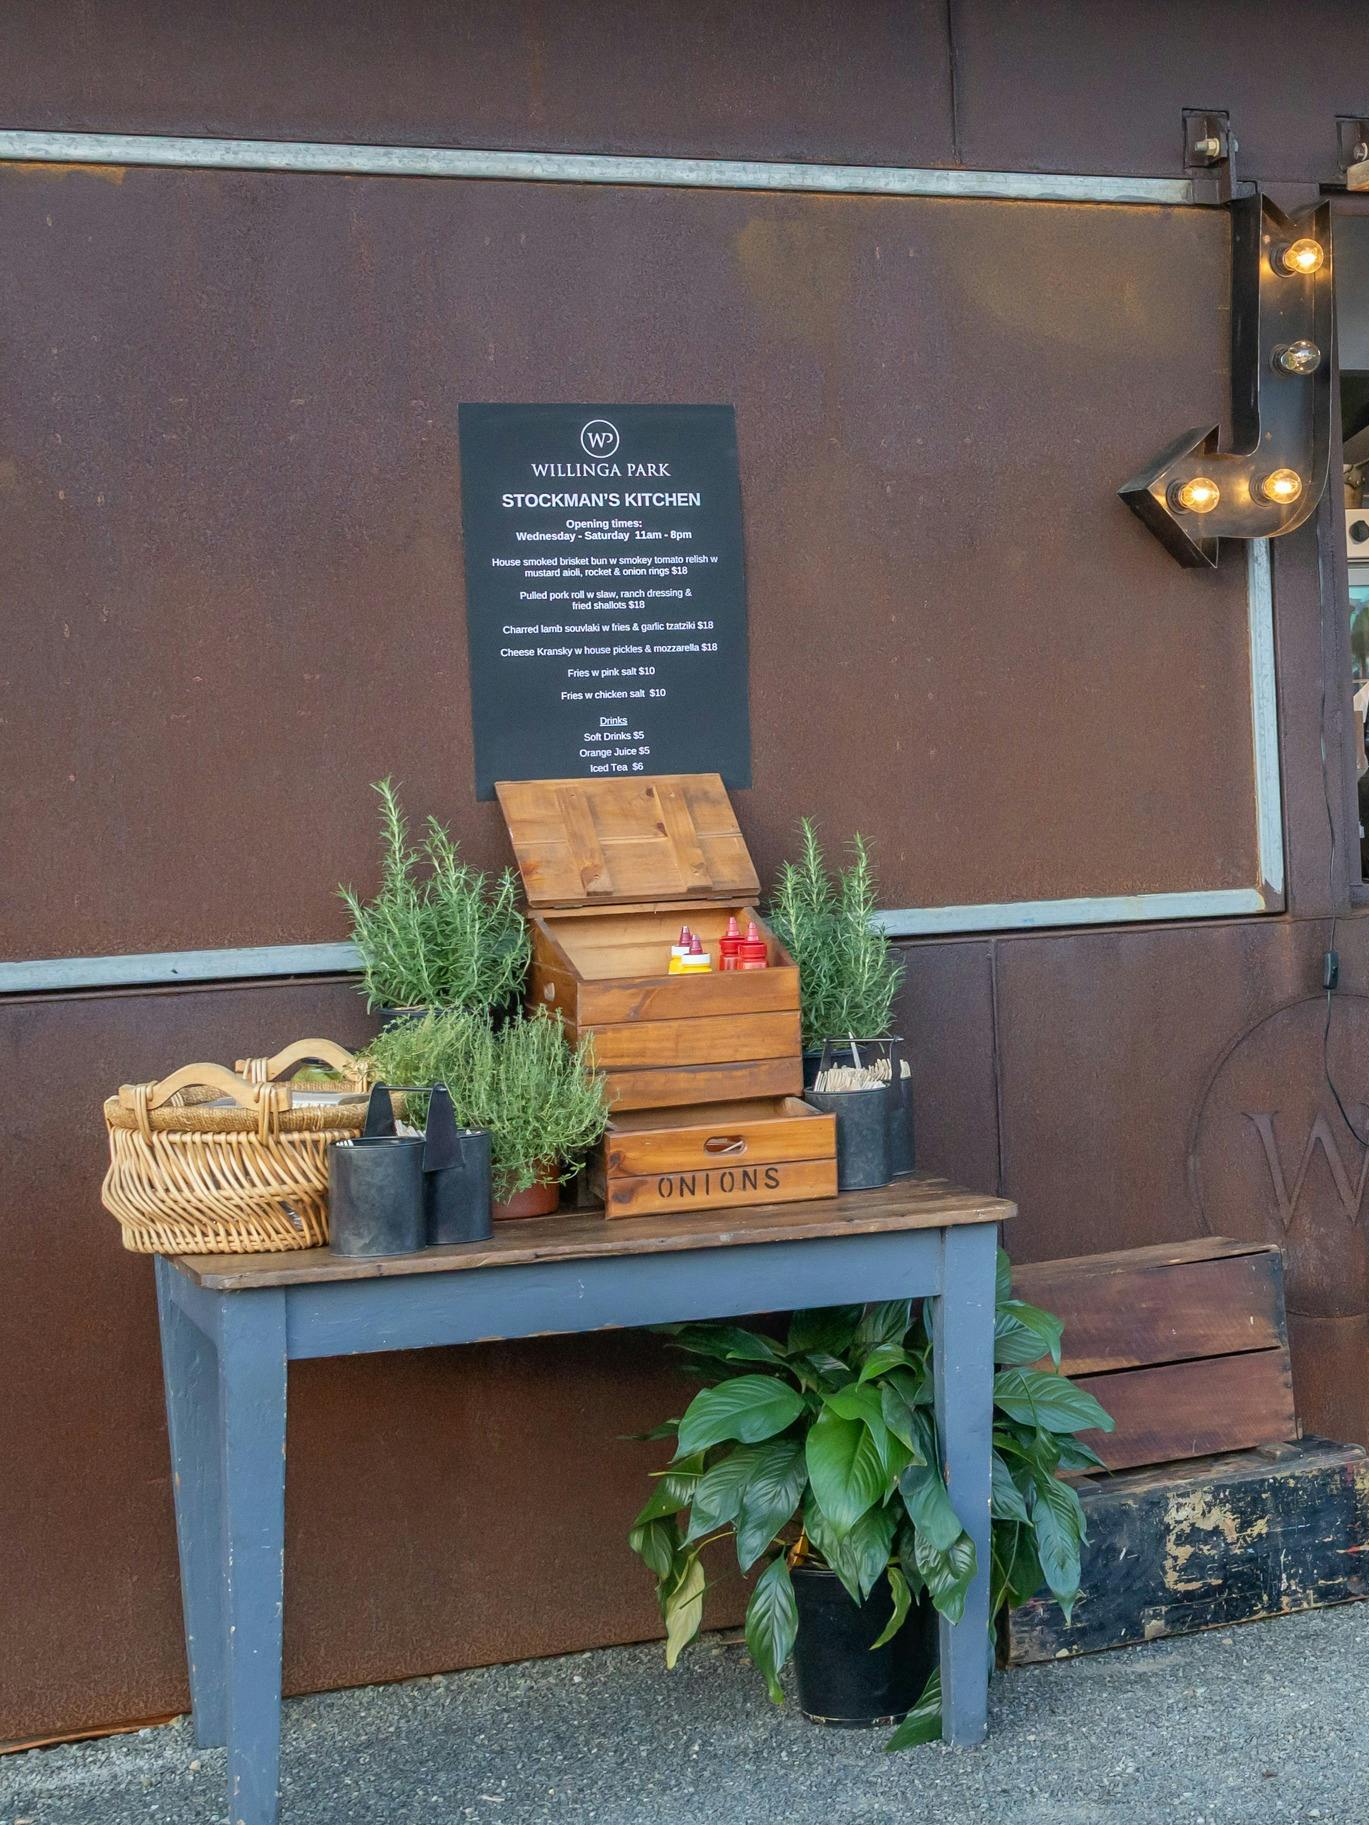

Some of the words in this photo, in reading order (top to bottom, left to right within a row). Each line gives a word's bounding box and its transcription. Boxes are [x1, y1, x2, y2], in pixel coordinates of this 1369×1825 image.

[531, 463, 622, 477] WILLINGA
[627, 463, 671, 477] PARK
[502, 493, 621, 508] STOCKMAN'S
[624, 492, 701, 507] KITCHEN
[566, 518, 610, 531] Opening
[611, 518, 643, 528] times:
[515, 531, 577, 543] Wednesday
[584, 529, 630, 542] Saturday
[634, 530, 663, 540] 11am
[670, 530, 692, 541] 8pm
[491, 558, 521, 567] House
[522, 557, 558, 566] smoked
[559, 556, 590, 566] brisket
[590, 556, 608, 565] bun
[618, 555, 653, 566] smokey
[654, 556, 684, 564] tomato
[685, 554, 709, 564] relish
[524, 568, 561, 577] mustard
[562, 568, 583, 578] aioli,
[584, 567, 612, 577] rocket
[613, 567, 621, 576] &
[622, 566, 647, 576] onion
[648, 566, 670, 577] rings
[671, 566, 688, 575] $18
[519, 590, 548, 600] Pulled
[549, 590, 570, 601] pork
[571, 590, 585, 599] roll
[596, 590, 619, 599] slaw,
[620, 589, 646, 598] ranch
[646, 588, 684, 599] dressing
[684, 588, 693, 597] &
[572, 601, 592, 610] fried
[593, 600, 627, 610] shallots
[628, 600, 646, 609] $18
[502, 624, 539, 635] Charred
[540, 624, 563, 633] lamb
[564, 623, 601, 633] souvlaki
[611, 623, 631, 632] fries
[632, 622, 640, 631] &
[640, 622, 665, 633] garlic
[665, 621, 696, 630] tzatziki
[697, 620, 714, 630] $18
[500, 648, 535, 657] Cheese
[536, 646, 573, 657] Kransky
[584, 645, 612, 655] house
[612, 644, 643, 656] pickles
[644, 644, 652, 653] &
[653, 643, 700, 653] mozzarella
[701, 642, 718, 652] $18
[567, 668, 591, 678] Fries
[601, 667, 620, 678] pink
[621, 667, 638, 676] salt
[638, 666, 656, 676] $10
[561, 691, 584, 700] Fries
[594, 690, 628, 699] chicken
[629, 689, 646, 698] salt
[649, 688, 667, 698] $10
[599, 716, 628, 727] Drinks
[583, 732, 602, 742] Soft
[603, 731, 632, 741] Drinks
[632, 730, 645, 740] $5
[579, 749, 613, 759] Orange
[613, 747, 638, 756] Juice
[638, 746, 651, 755] $5
[590, 763, 609, 773] Iced
[610, 763, 629, 772] Tea
[632, 762, 644, 771] $6
[657, 1167, 781, 1199] ONIONS
